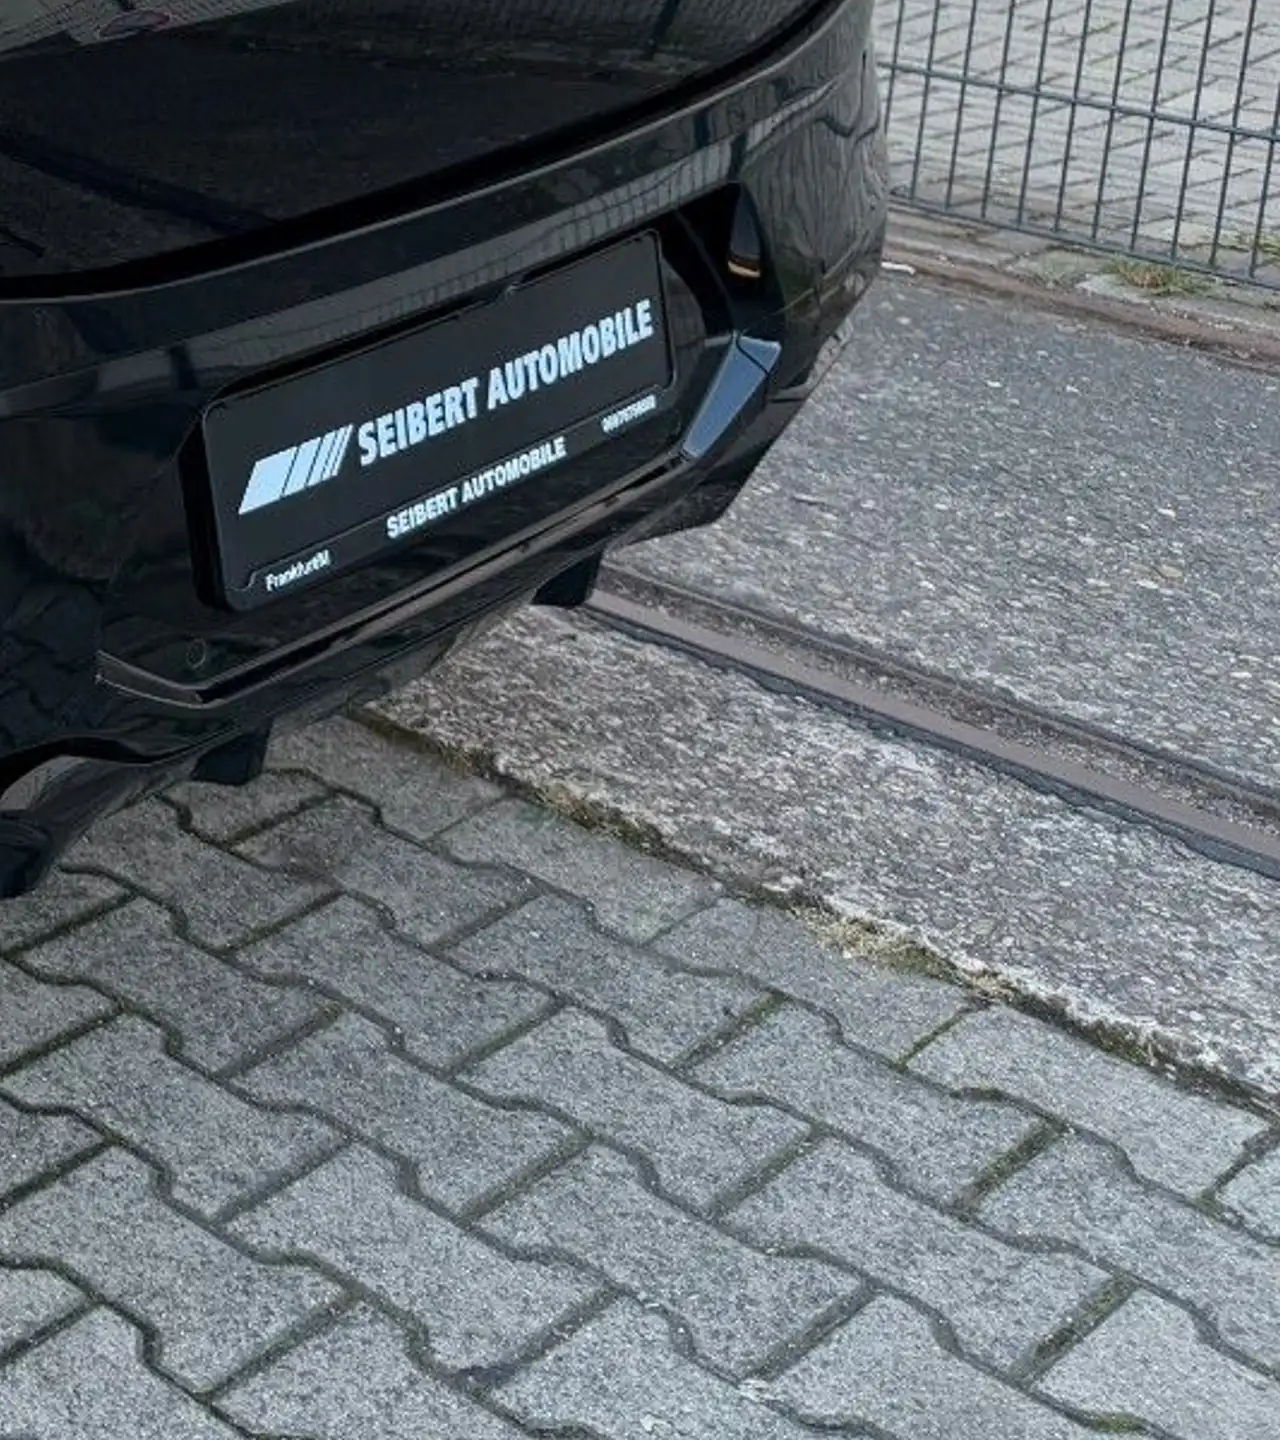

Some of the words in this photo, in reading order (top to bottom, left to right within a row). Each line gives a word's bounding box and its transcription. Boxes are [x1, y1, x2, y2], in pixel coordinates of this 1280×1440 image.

[357, 376, 480, 467] SEIBERT
[487, 298, 655, 410] AUTOMOBILE
[386, 486, 459, 539] SEIBERT
[461, 435, 568, 505] AUTOMOBILE
